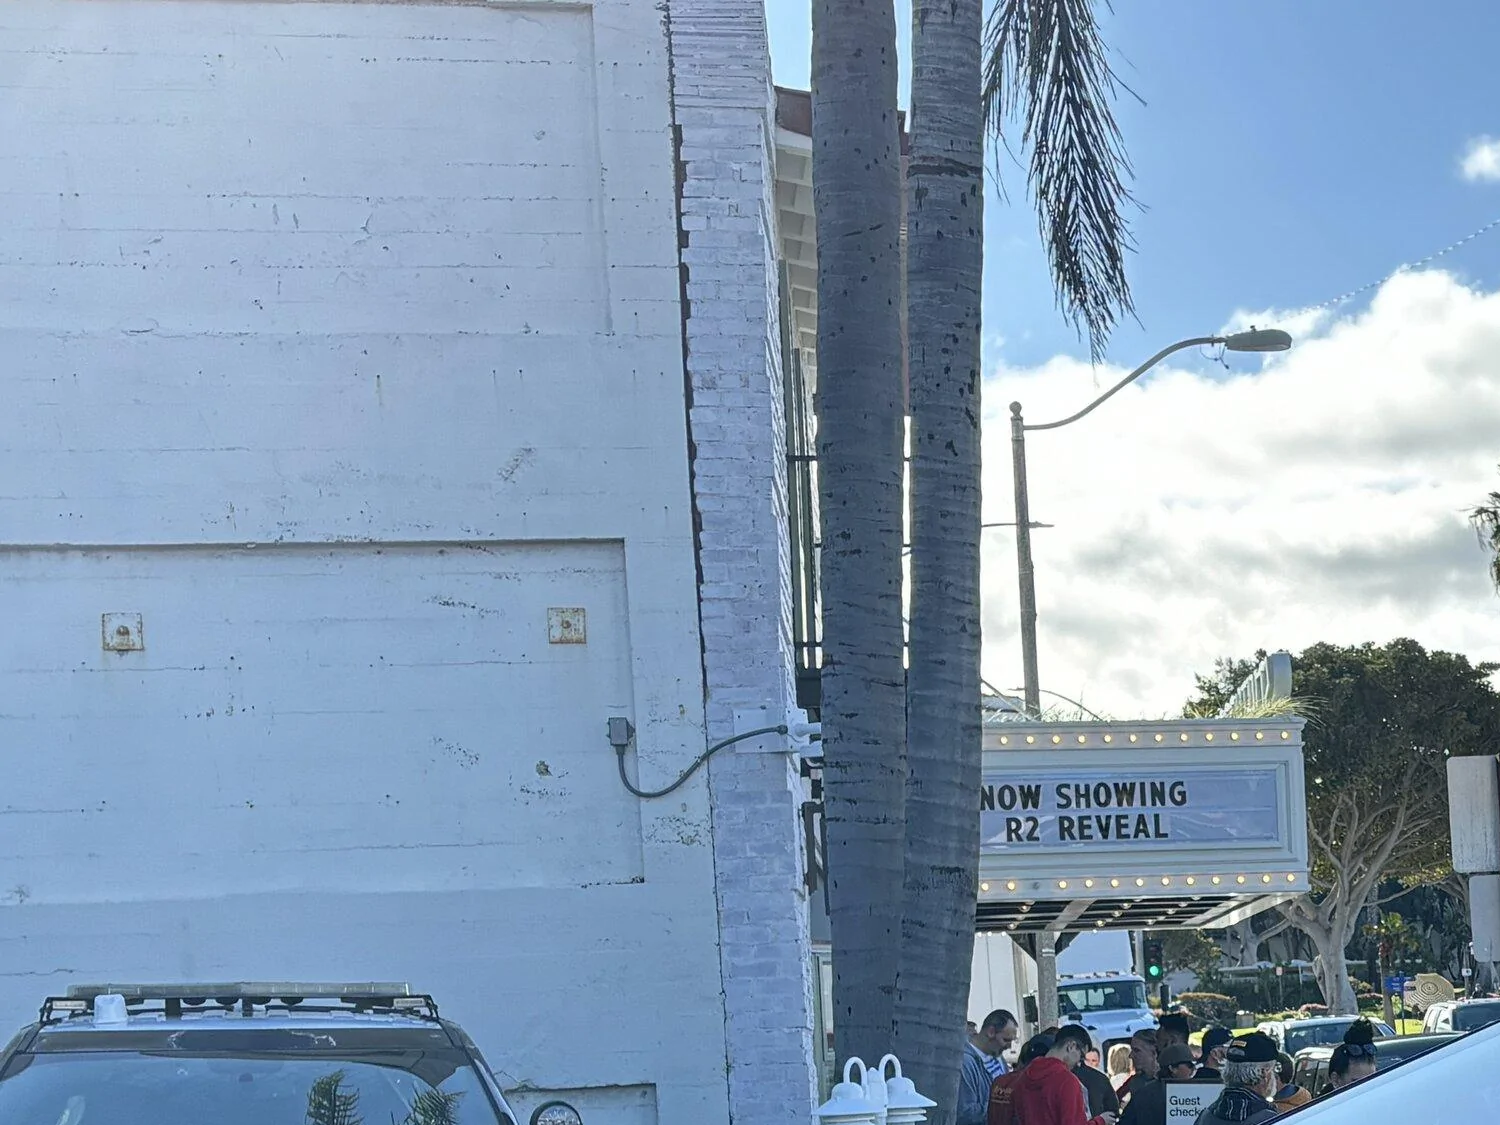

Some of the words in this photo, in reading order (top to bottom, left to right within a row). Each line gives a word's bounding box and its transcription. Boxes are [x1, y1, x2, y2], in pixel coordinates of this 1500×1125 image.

[981, 784, 1042, 811] NOW
[1055, 780, 1188, 810] SHOWING
[1005, 816, 1041, 843] R2
[1058, 813, 1170, 842] REVEAL
[1169, 1095, 1201, 1106] Guest
